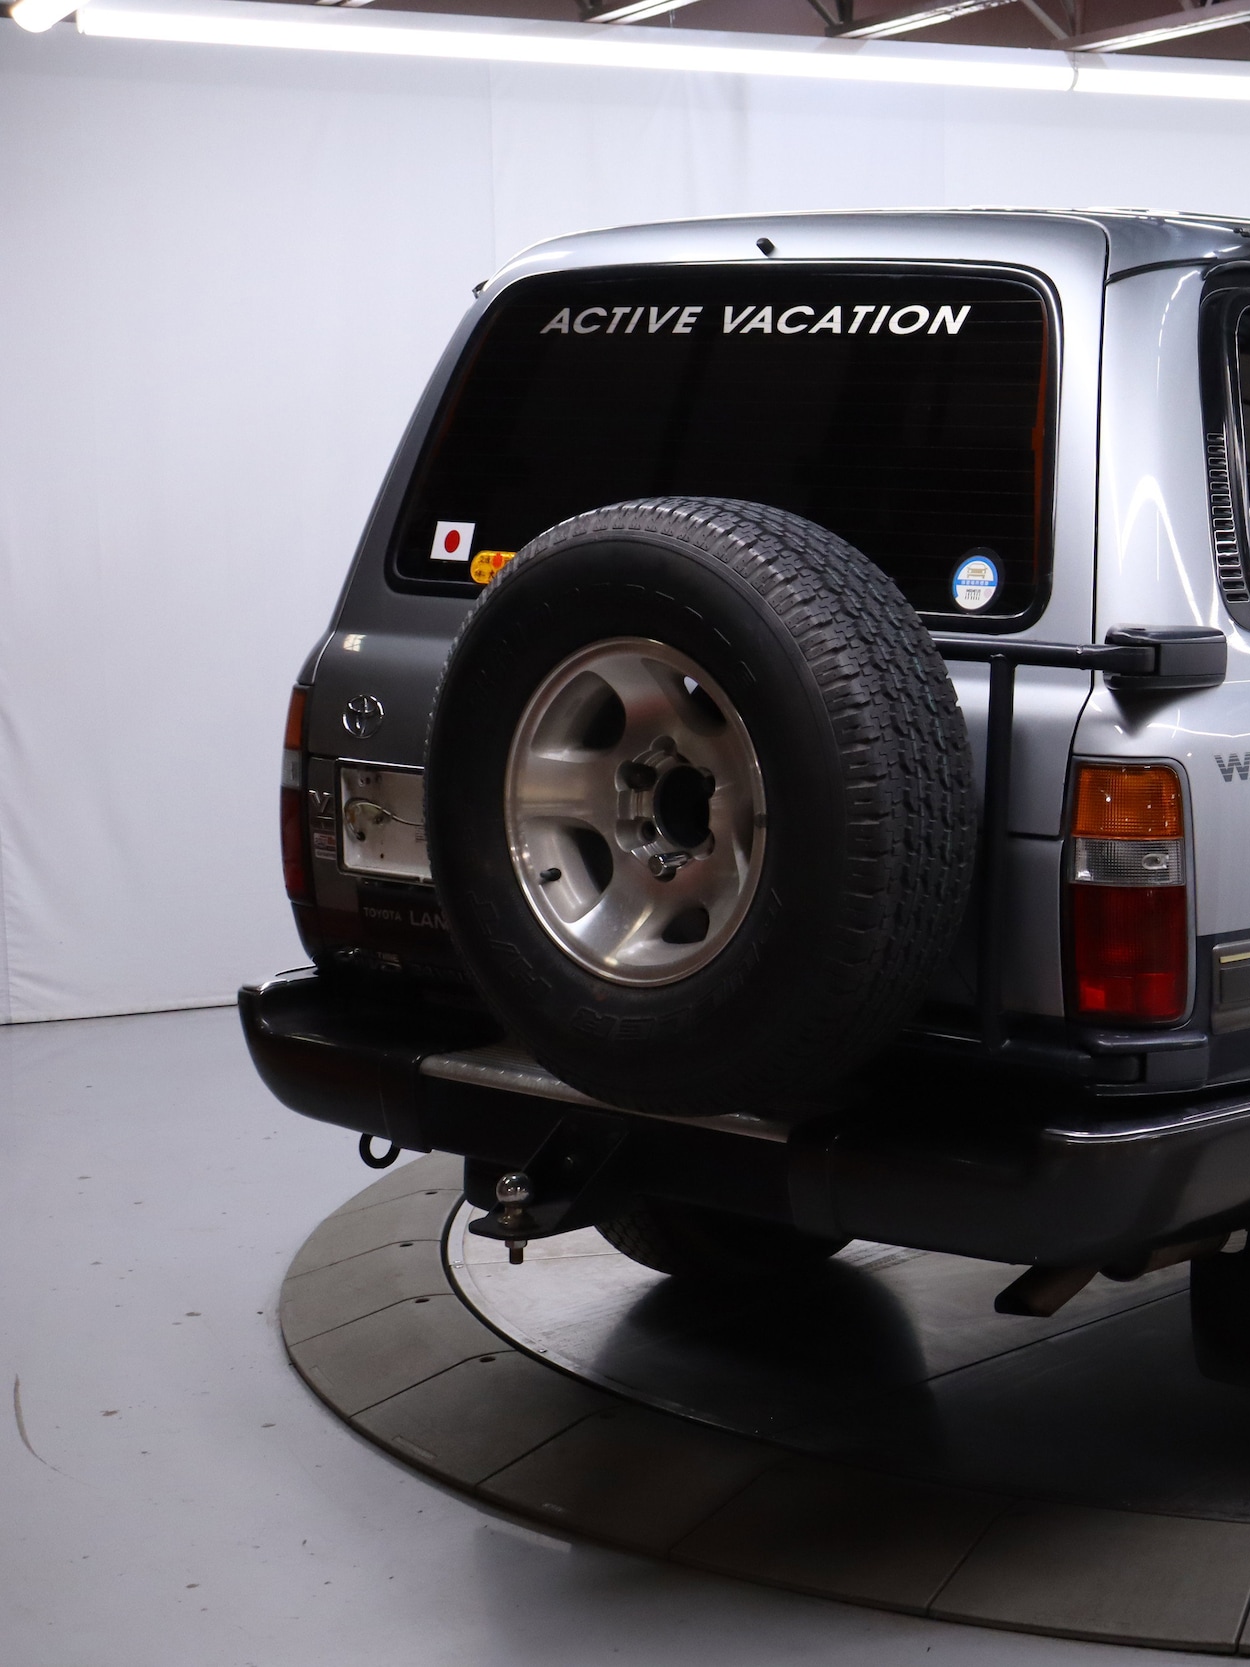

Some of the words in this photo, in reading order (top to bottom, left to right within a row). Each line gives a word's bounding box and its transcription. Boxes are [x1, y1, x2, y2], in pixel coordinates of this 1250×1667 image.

[540, 306, 704, 335] ACTIVE
[722, 305, 972, 335] VACATION
[363, 906, 402, 922] TOYOTA
